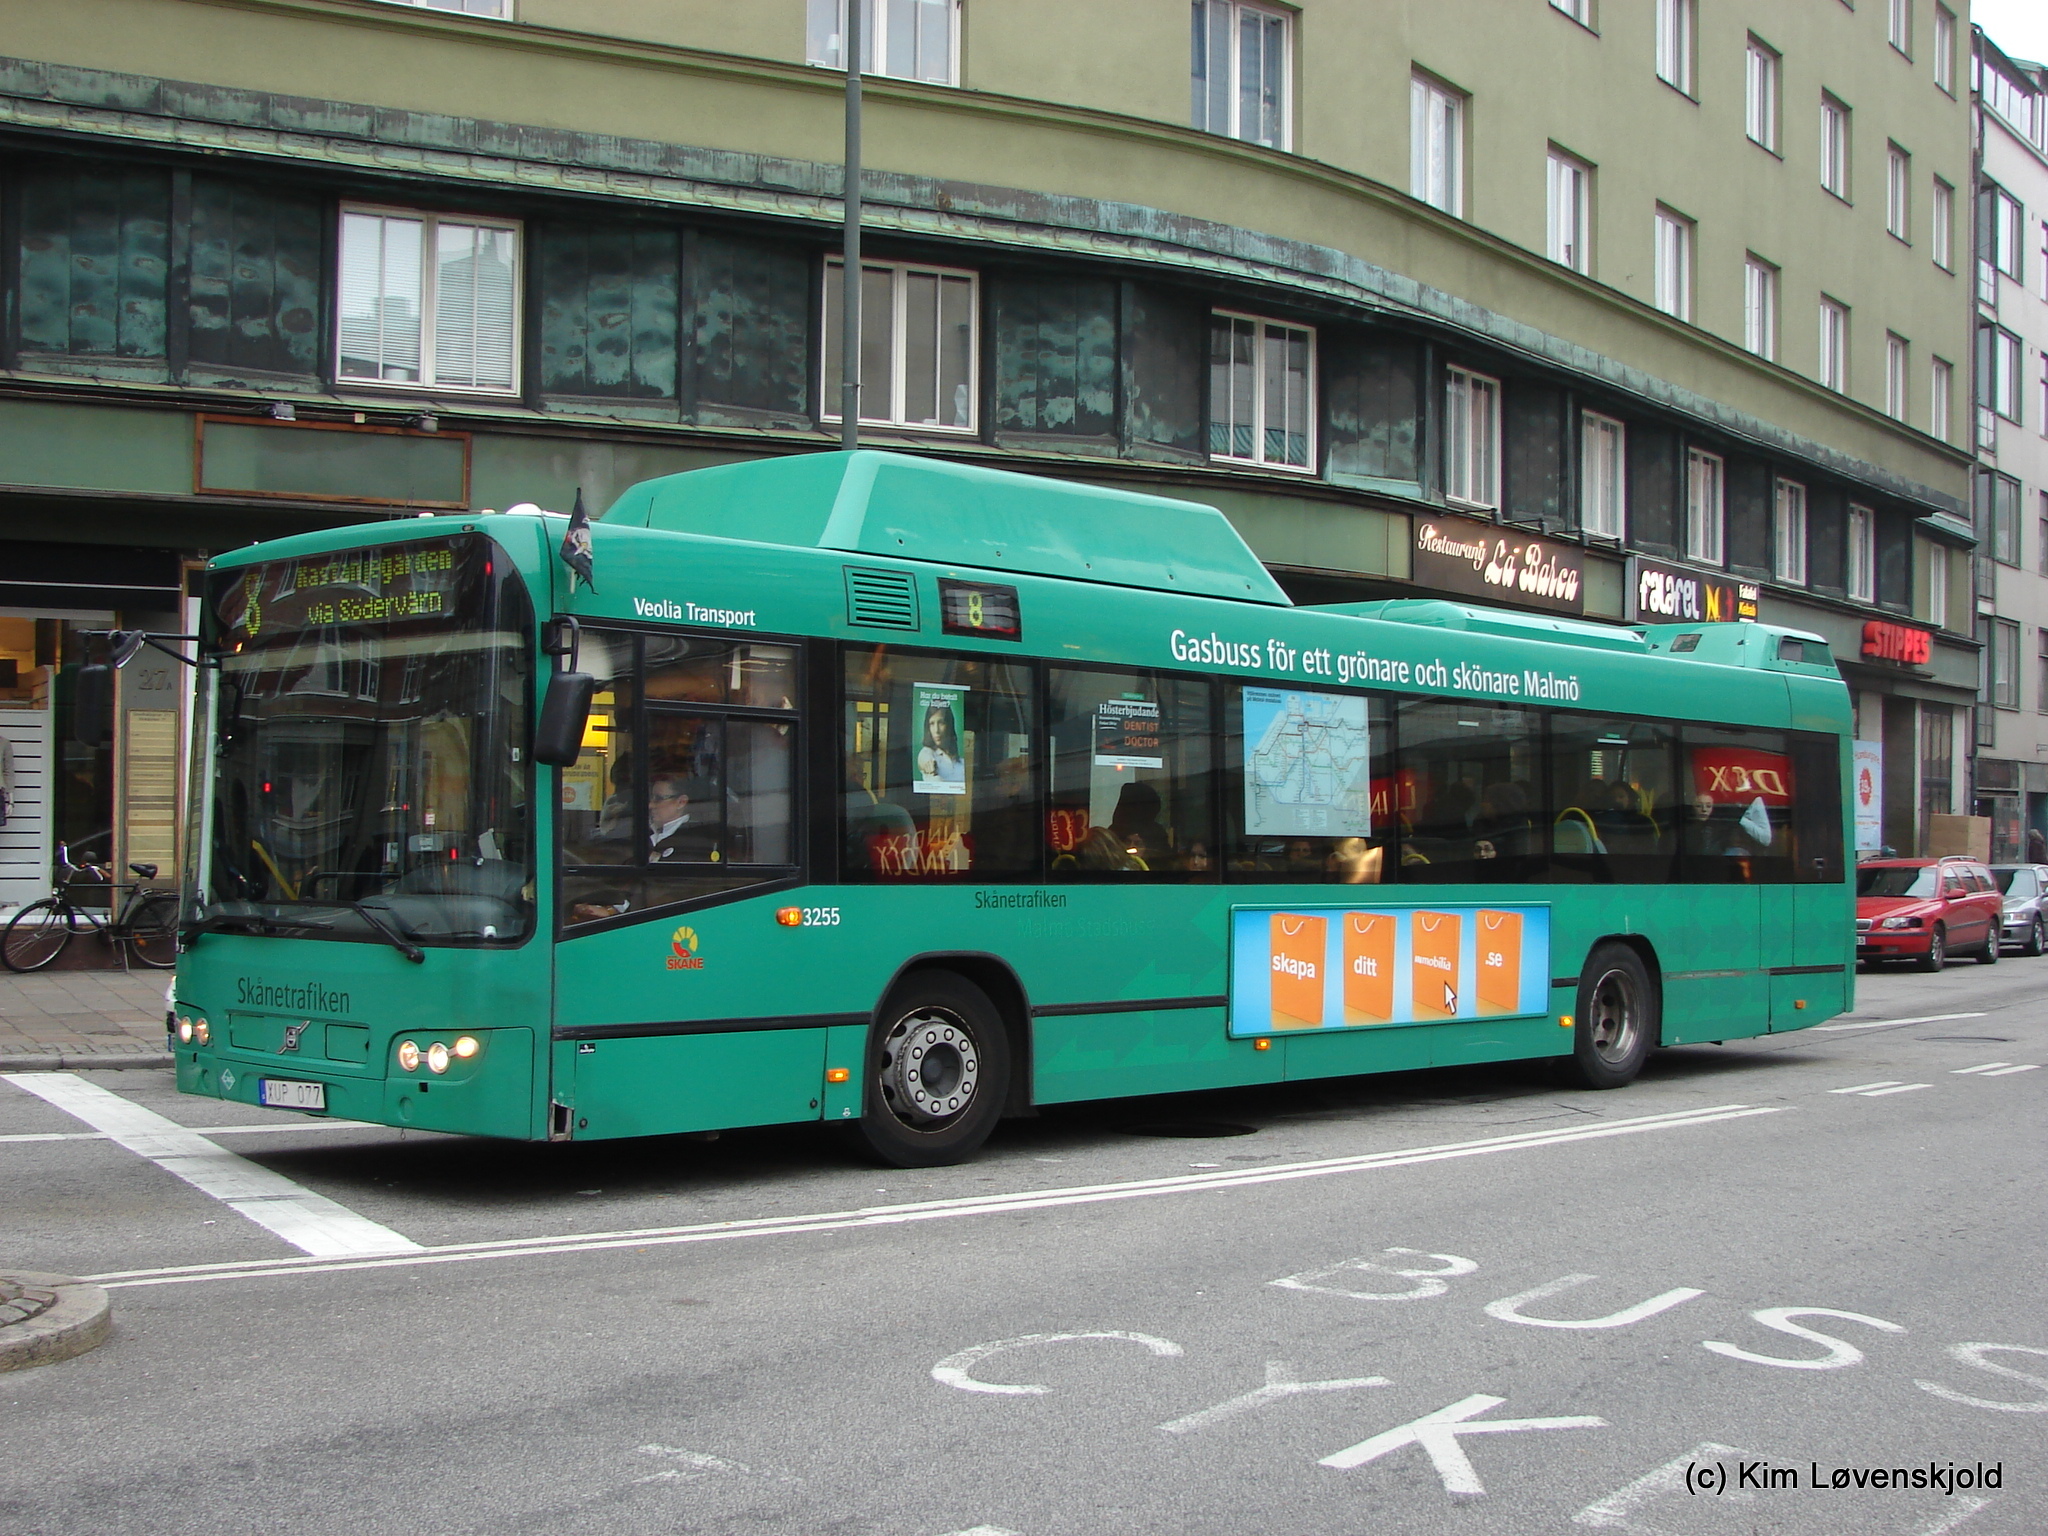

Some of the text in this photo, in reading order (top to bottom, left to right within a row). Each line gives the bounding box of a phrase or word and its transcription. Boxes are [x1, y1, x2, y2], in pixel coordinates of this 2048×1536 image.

[1418, 523, 1487, 571] Restaurang
[245, 573, 261, 635] 8
[308, 602, 334, 624] via
[633, 597, 757, 628] Veolia Transport
[968, 590, 983, 627] 8
[1170, 628, 1580, 702] Gasbuss för ett grönare och skönare Malmö
[932, 692, 940, 700] du
[1099, 703, 1159, 719] Hösterbjudande
[1124, 720, 1159, 733] DENTIST
[1124, 736, 1159, 748] DOCTOR
[975, 889, 1067, 909] Skånetrafiken
[803, 907, 841, 927] 3255
[1272, 952, 1316, 980] skapa
[1353, 955, 1378, 977] ditt
[1485, 951, 1504, 968] .se
[237, 977, 351, 1014] Skånetrafiken
[297, 1085, 321, 1105] 077
